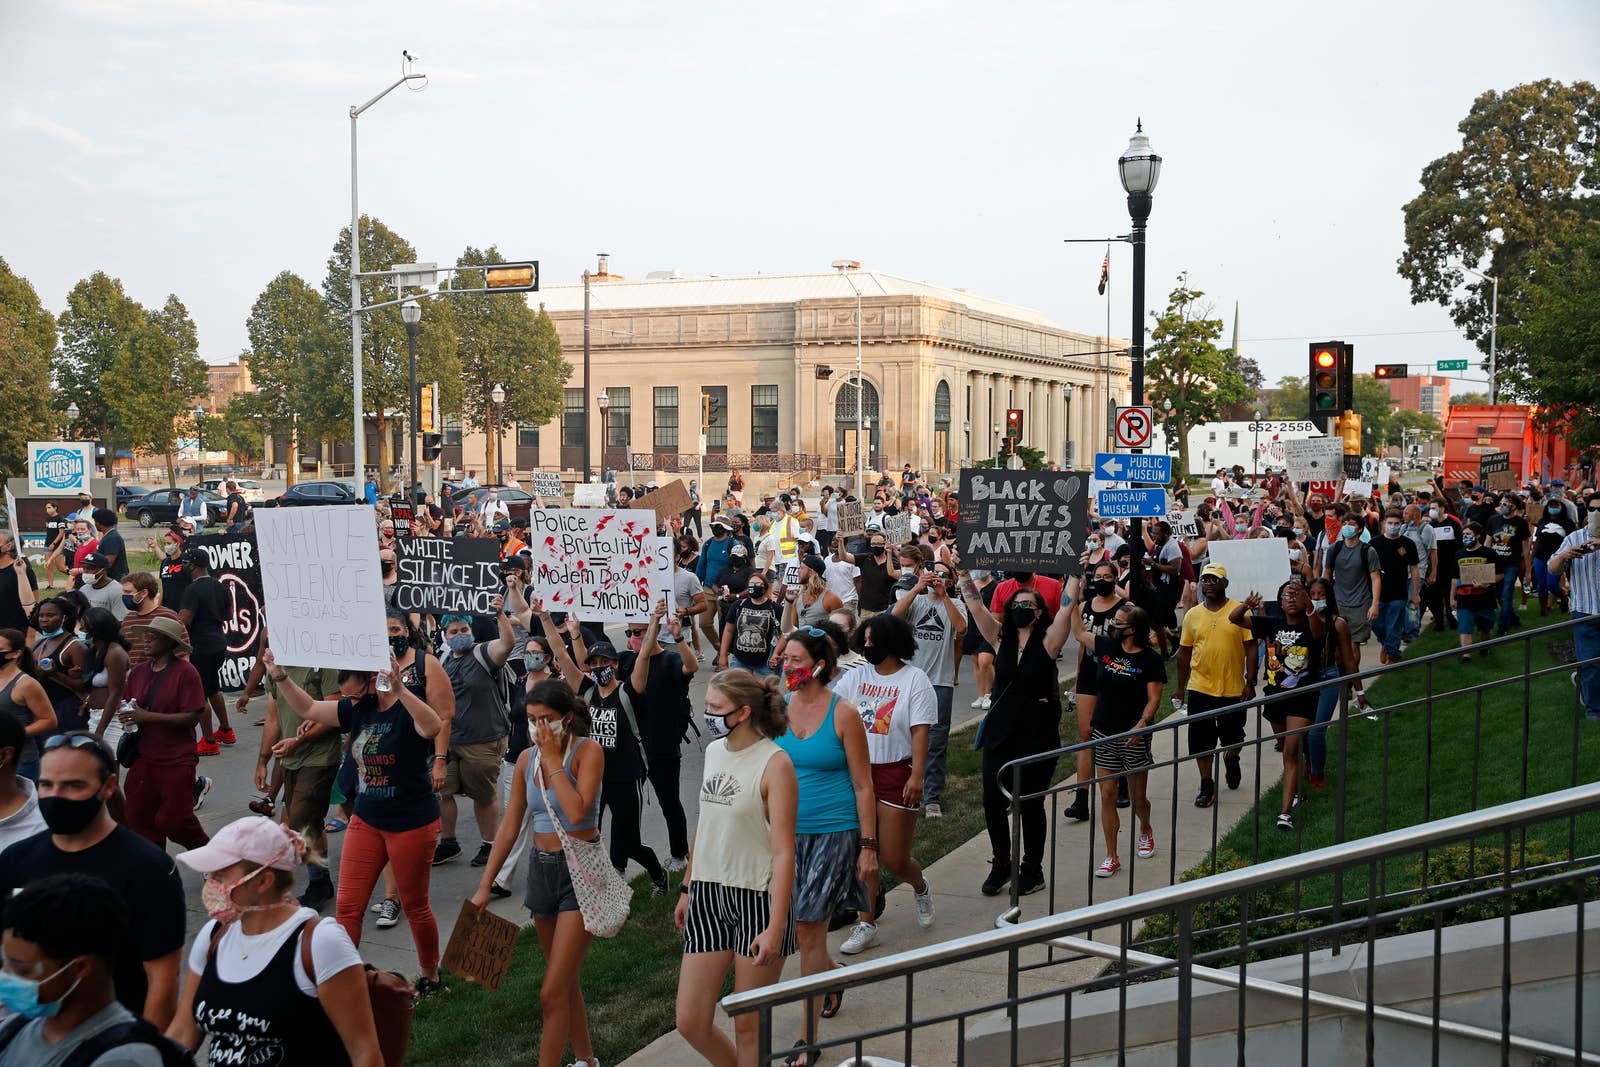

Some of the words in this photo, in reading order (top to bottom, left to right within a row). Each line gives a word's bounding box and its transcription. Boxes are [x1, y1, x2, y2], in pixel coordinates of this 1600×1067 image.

[1127, 416, 1144, 438] P
[1248, 422, 1313, 432] 652-2558
[36, 458, 82, 480] KENOSHA
[1130, 457, 1164, 469] PUBLIC
[1126, 469, 1166, 481] MUSEUM
[970, 475, 1046, 502] BLACK
[1102, 492, 1148, 502] DINOSAUR
[986, 504, 1072, 528] LIVES
[1103, 505, 1140, 514] MUSEUM
[534, 510, 588, 532] Police
[1171, 524, 1196, 536] OLENCE
[23, 539, 46, 549] KEN
[260, 508, 368, 560] WHITE
[967, 530, 1076, 556] MATTER
[399, 538, 454, 560] WHITE
[562, 534, 643, 558] Brutality
[266, 562, 372, 604] SILENCE
[399, 558, 474, 588] SILENCE
[476, 562, 500, 590] IS
[538, 564, 595, 584] Modern
[600, 568, 630, 584] Day
[290, 600, 350, 620] EQUALS
[580, 586, 650, 612] Lynching
[272, 626, 382, 658] VIOLENCE
[589, 706, 616, 721] BLACK
[592, 722, 616, 736] IVES
[591, 736, 616, 748] ATTER
[365, 776, 390, 786] CARE
[208, 1008, 232, 1025] see
[236, 1012, 270, 1032] you
